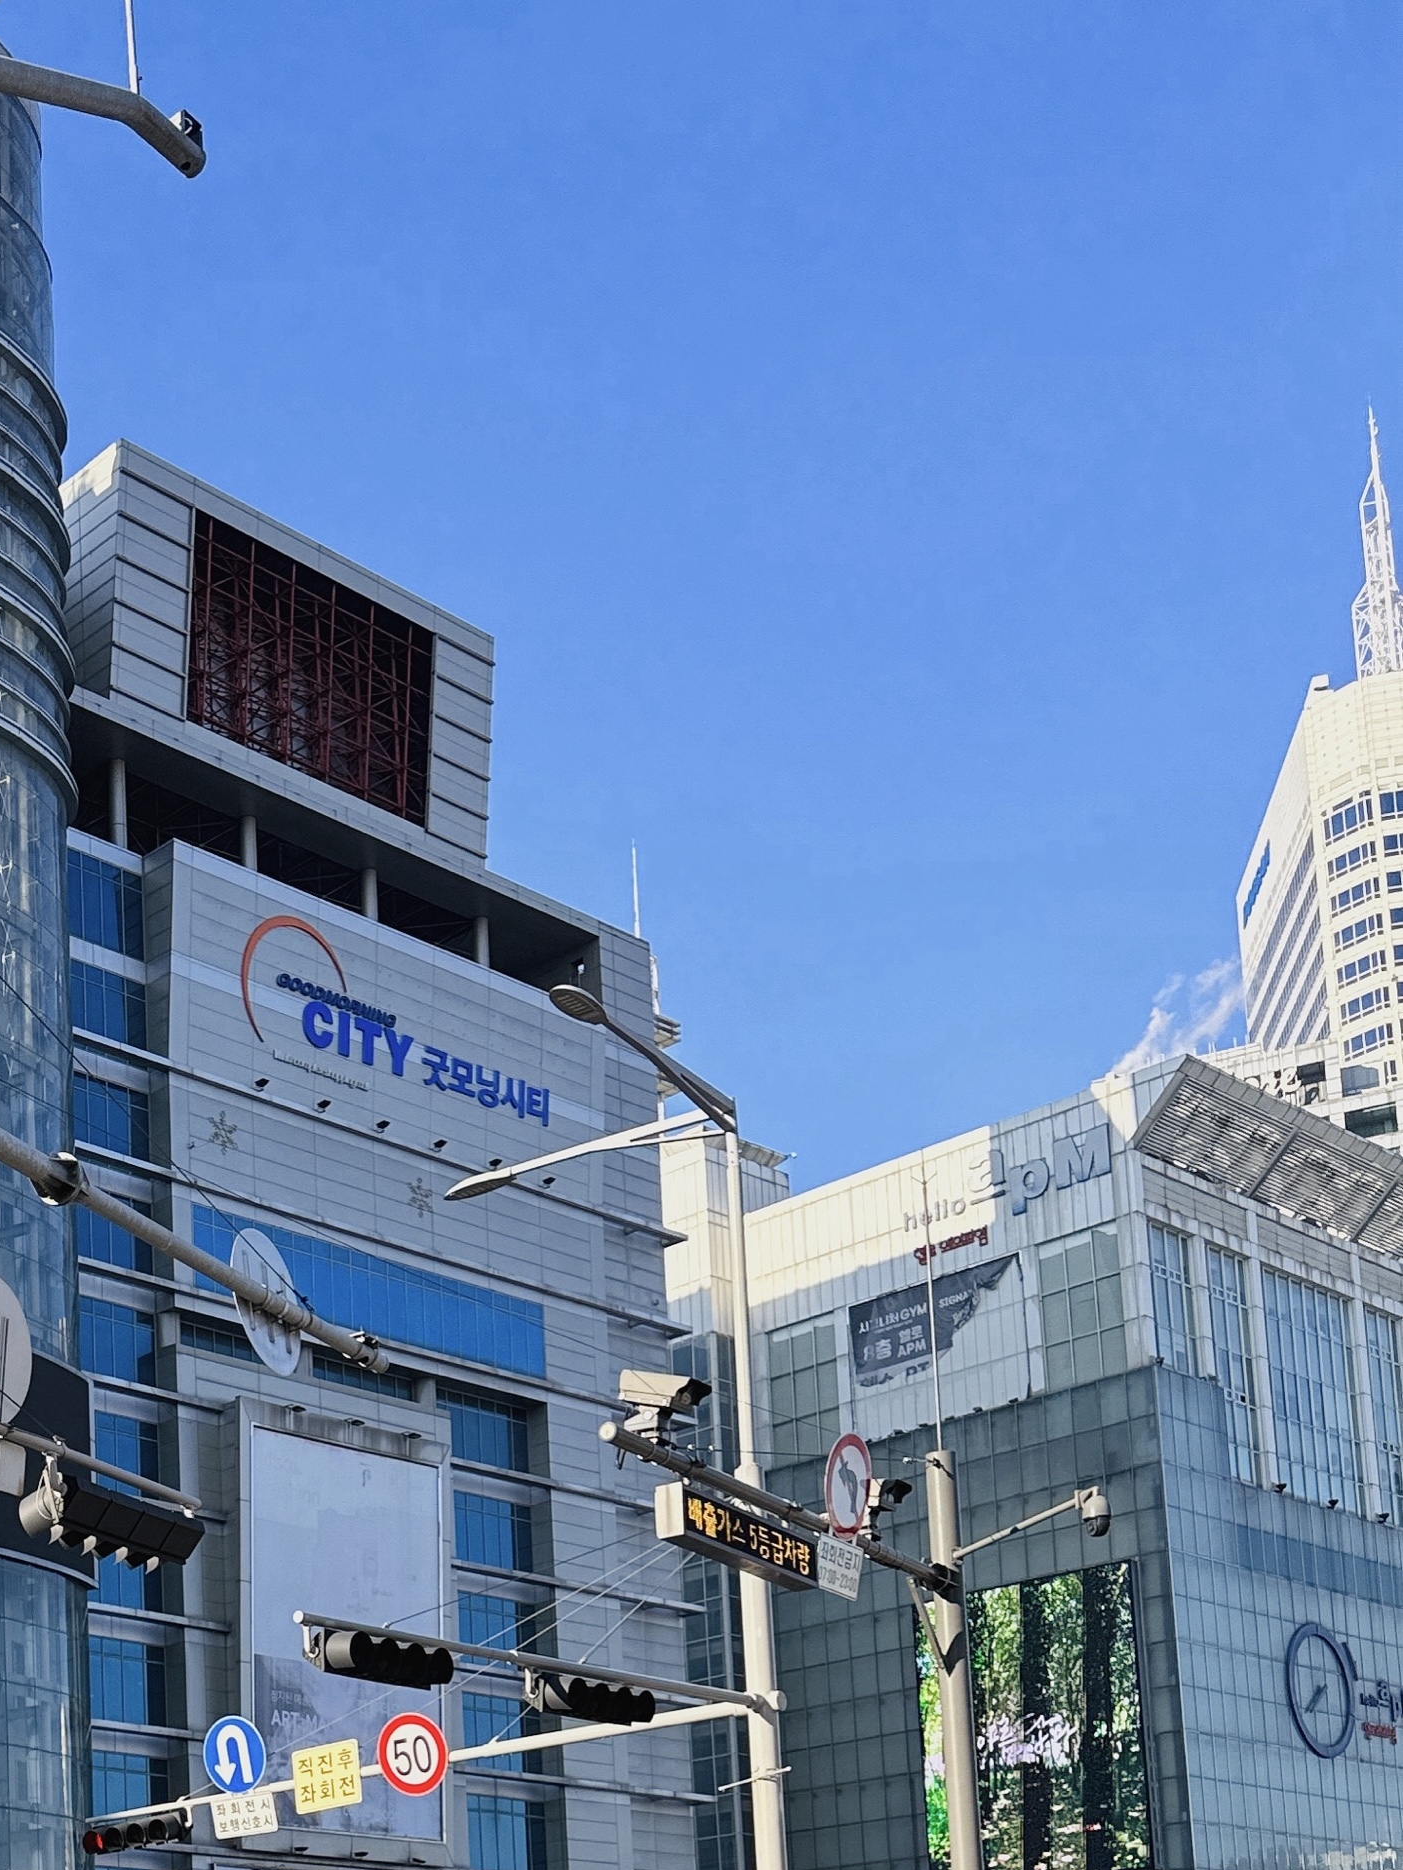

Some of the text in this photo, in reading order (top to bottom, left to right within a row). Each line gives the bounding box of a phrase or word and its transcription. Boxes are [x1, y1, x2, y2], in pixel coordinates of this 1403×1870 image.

[276, 973, 396, 1028] GOODMORNING
[302, 1001, 414, 1077] CITY
[421, 1045, 549, 1127] 굿모닝시티
[900, 1302, 928, 1322] GYM
[897, 1338, 927, 1359] APM
[688, 1498, 811, 1576] 배출가스 5등급차량
[820, 1541, 861, 1572] 좌회전금지
[298, 1748, 354, 1777] 직진후
[393, 1735, 432, 1776] 50
[300, 1774, 356, 1804] 좌회전
[218, 1818, 275, 1834] 보행신호시
